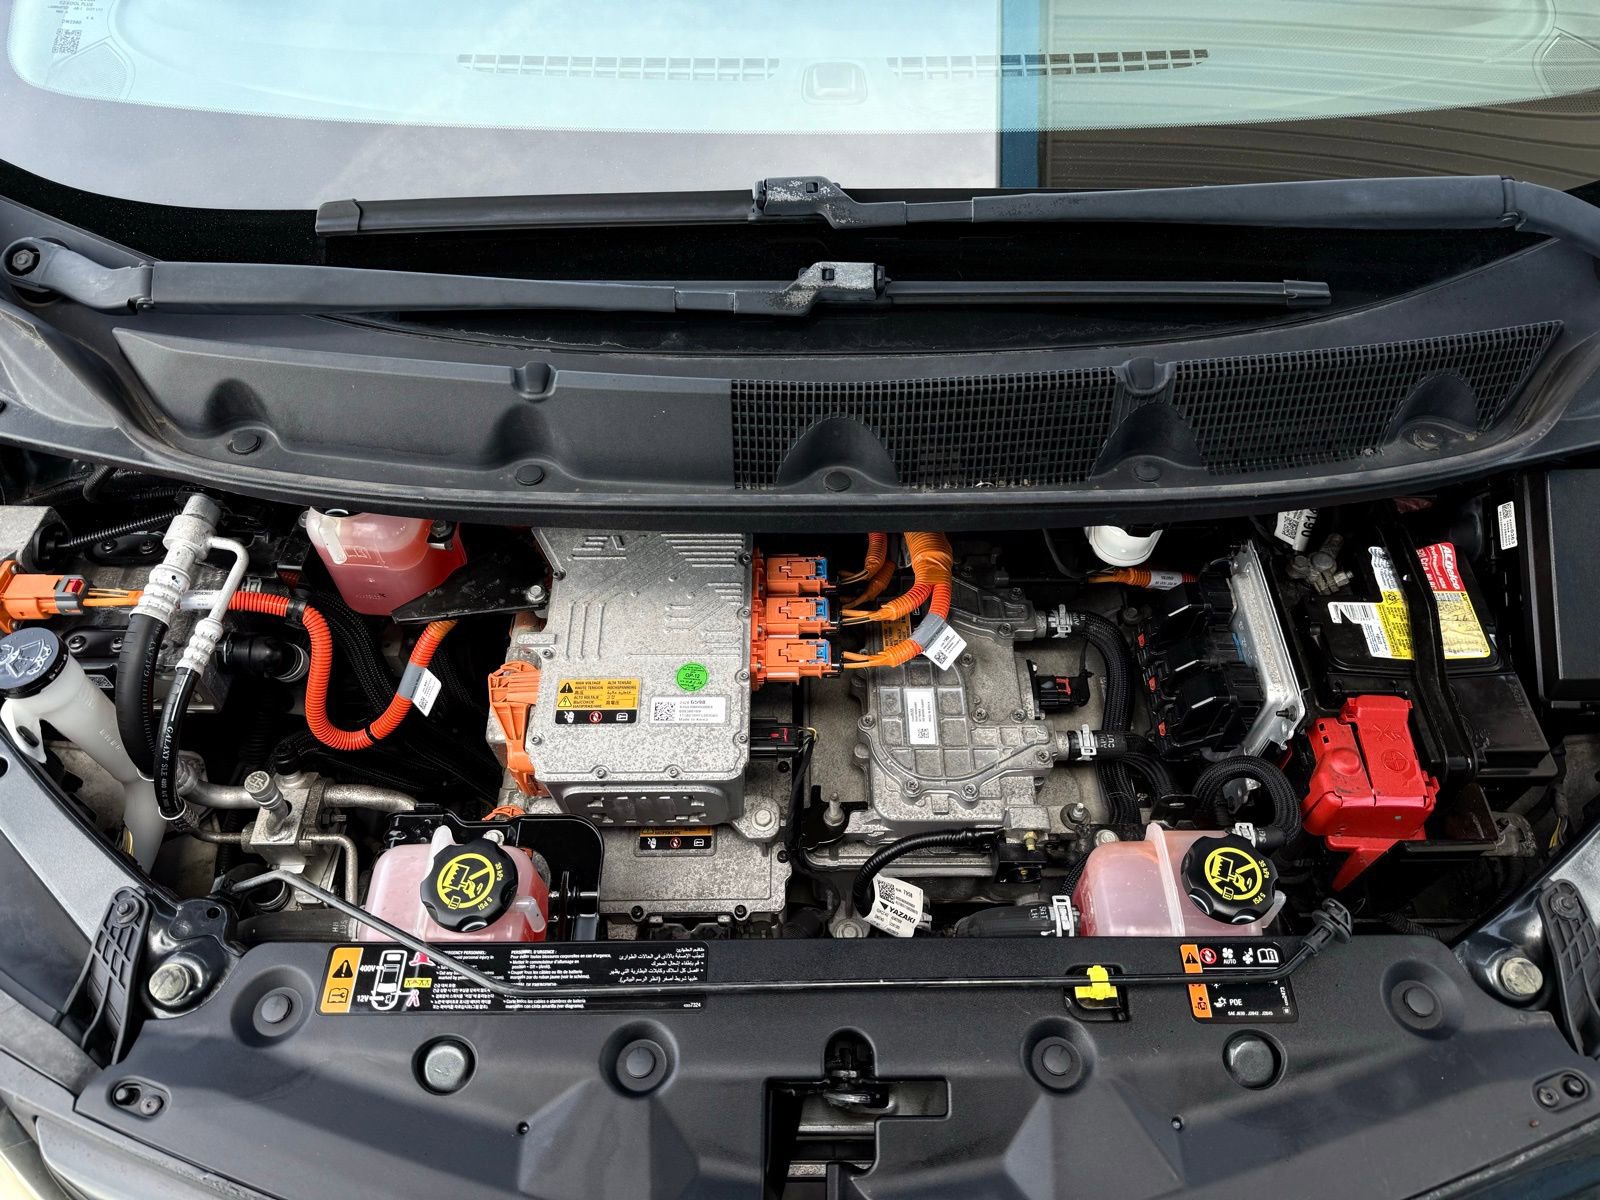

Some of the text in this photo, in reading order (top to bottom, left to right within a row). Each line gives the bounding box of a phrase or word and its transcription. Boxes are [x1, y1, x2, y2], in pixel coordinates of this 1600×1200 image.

[1430, 545, 1443, 577] Professional
[1441, 545, 1461, 590] ACDelco
[144, 639, 156, 677] GALAXY
[162, 726, 174, 761] GALAXY
[889, 906, 916, 924] YAZAKI
